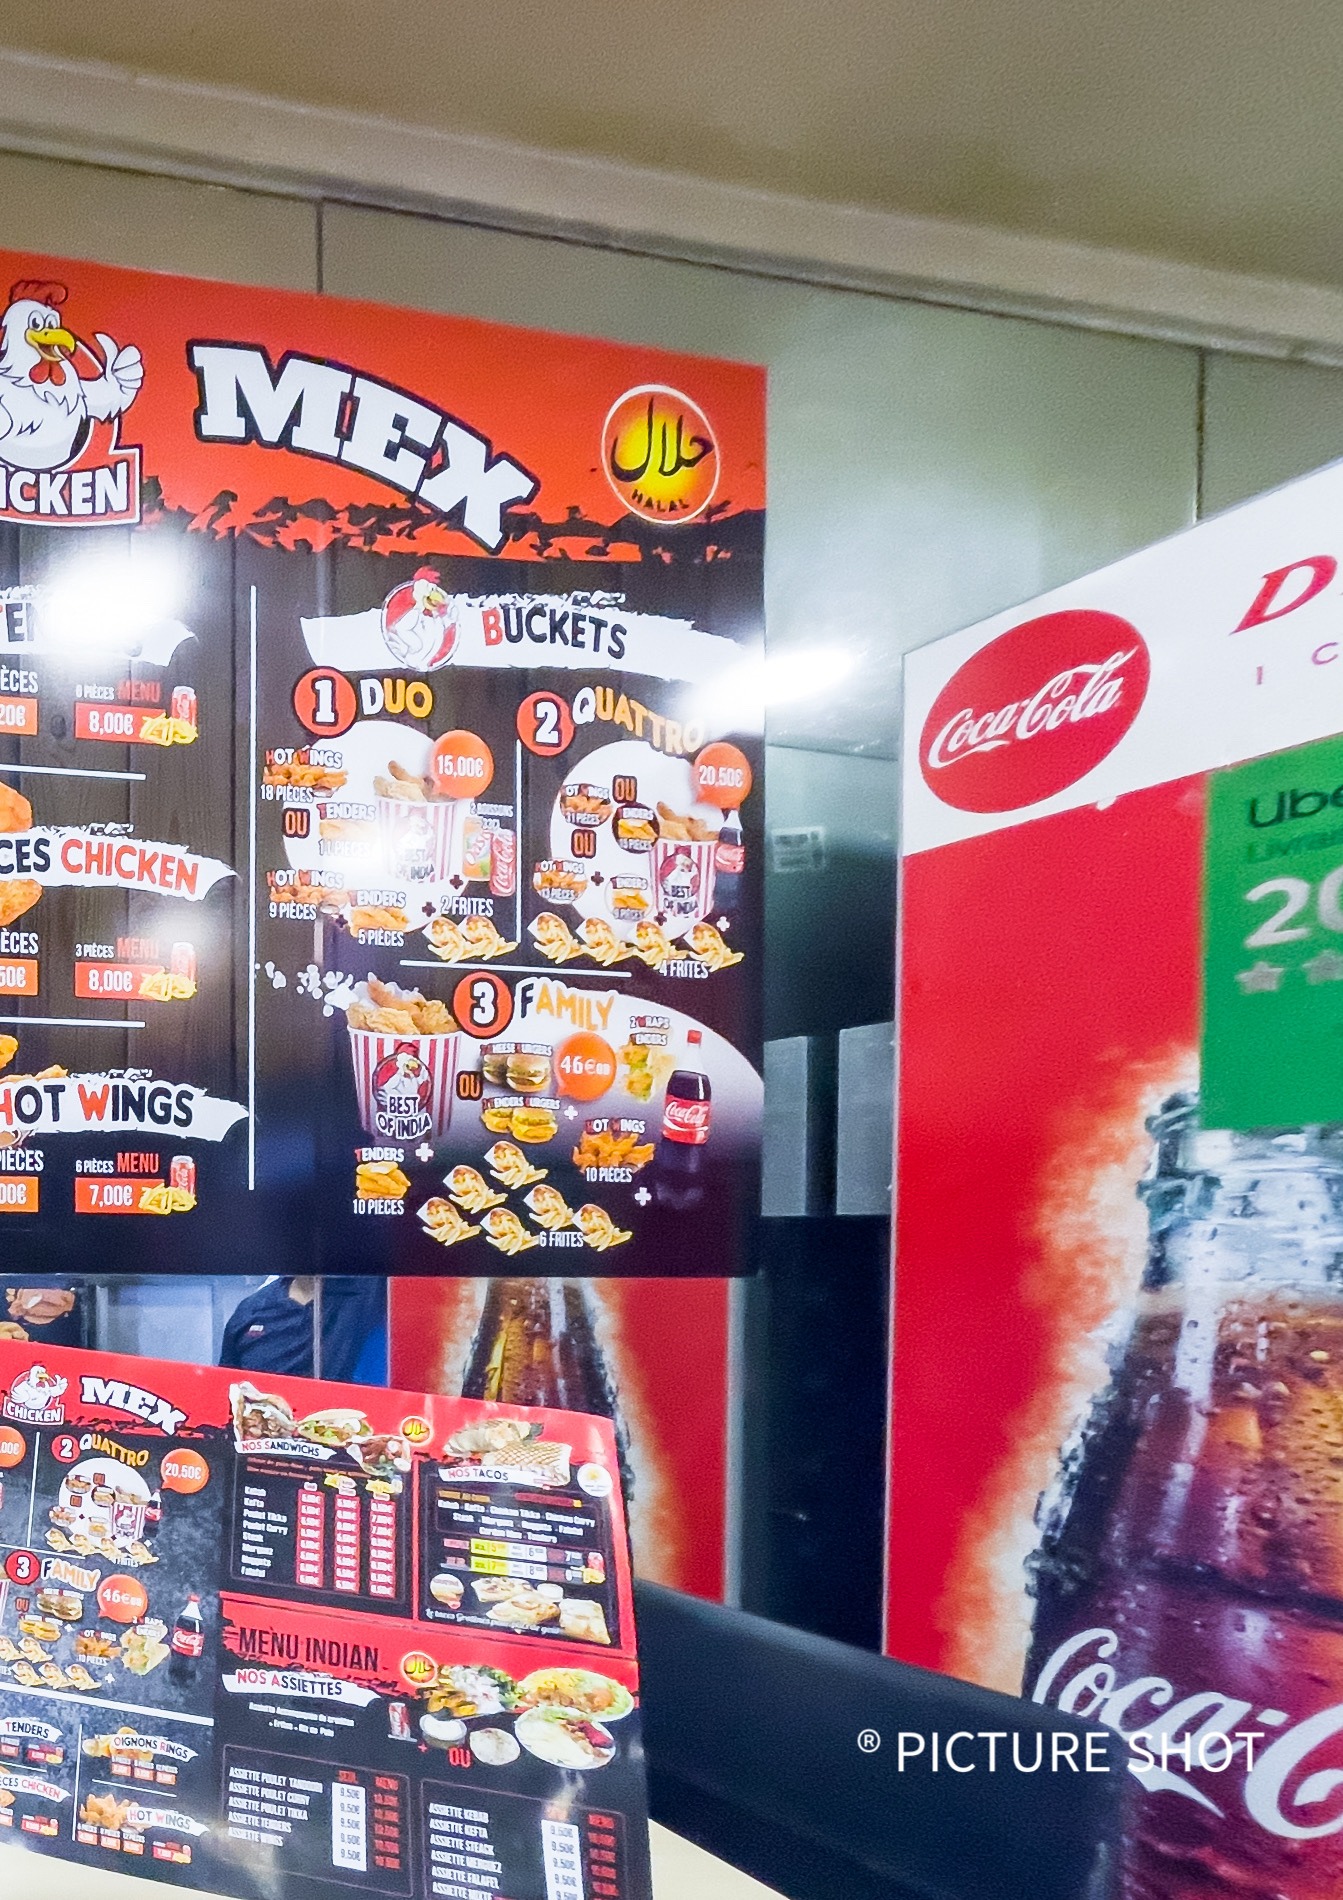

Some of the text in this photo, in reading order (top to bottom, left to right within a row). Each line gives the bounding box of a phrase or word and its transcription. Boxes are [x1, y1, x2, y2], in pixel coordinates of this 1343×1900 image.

[192, 344, 535, 551] MEX
[630, 487, 691, 511] HALAL
[482, 606, 628, 660] BUCKETS
[117, 680, 162, 703] MENU
[313, 677, 433, 723] 1 DUO
[928, 645, 1138, 769] Coca-Cola
[88, 710, 134, 736] 8,00€
[535, 686, 706, 754] 2 QUATTRO
[266, 748, 343, 769] HOT WINGS
[437, 754, 484, 778] 15,00€
[261, 783, 314, 803] 18 PIÈCES
[615, 777, 636, 802] OU
[316, 802, 376, 821] TENDERS
[285, 811, 308, 836] OU
[573, 831, 595, 856] OU
[60, 840, 199, 896] CHICKEN
[266, 869, 344, 890] HOT WINGS
[349, 890, 406, 908] TENDERS
[440, 896, 494, 917] 2 FRITES
[269, 902, 317, 921] 9 PIÈCES
[75, 944, 82, 957] 3
[117, 937, 159, 960] MENU
[358, 928, 404, 946] 5 PIÈCES
[88, 967, 133, 993] 8,00€
[659, 960, 709, 979] 4 FRITES
[471, 982, 615, 1031] 3 FAMILY
[459, 1073, 481, 1098] OU
[78, 1083, 194, 1128] WINGS
[389, 1096, 419, 1114] BEST
[376, 1113, 432, 1138] OF INDIA
[76, 1152, 159, 1175] 6 PIÈCES MENU
[354, 1147, 405, 1163] TENDERS
[586, 1167, 597, 1182] 10
[89, 1184, 133, 1207] 7,00€
[353, 1199, 366, 1215] 10
[539, 1231, 584, 1248] 6 FRITES
[7, 1401, 62, 1422] CHICKEN
[81, 1377, 188, 1435] MEX
[60, 1434, 150, 1467] 2 QUATTRO
[242, 1440, 320, 1457] NOS SANDWICHS
[473, 1469, 509, 1481] TACOS
[17, 1557, 99, 1590] 3 FAMILY
[240, 1627, 379, 1673] MENU INDIAN
[237, 1669, 343, 1696] NOS ASSIETTES
[6, 1721, 50, 1739] TENDERS
[114, 1736, 188, 1759] OIGNONS RINGS
[448, 1747, 471, 1768] OU
[22, 1777, 61, 1799] CHICKEN
[130, 1810, 191, 1830] HOT WINGS
